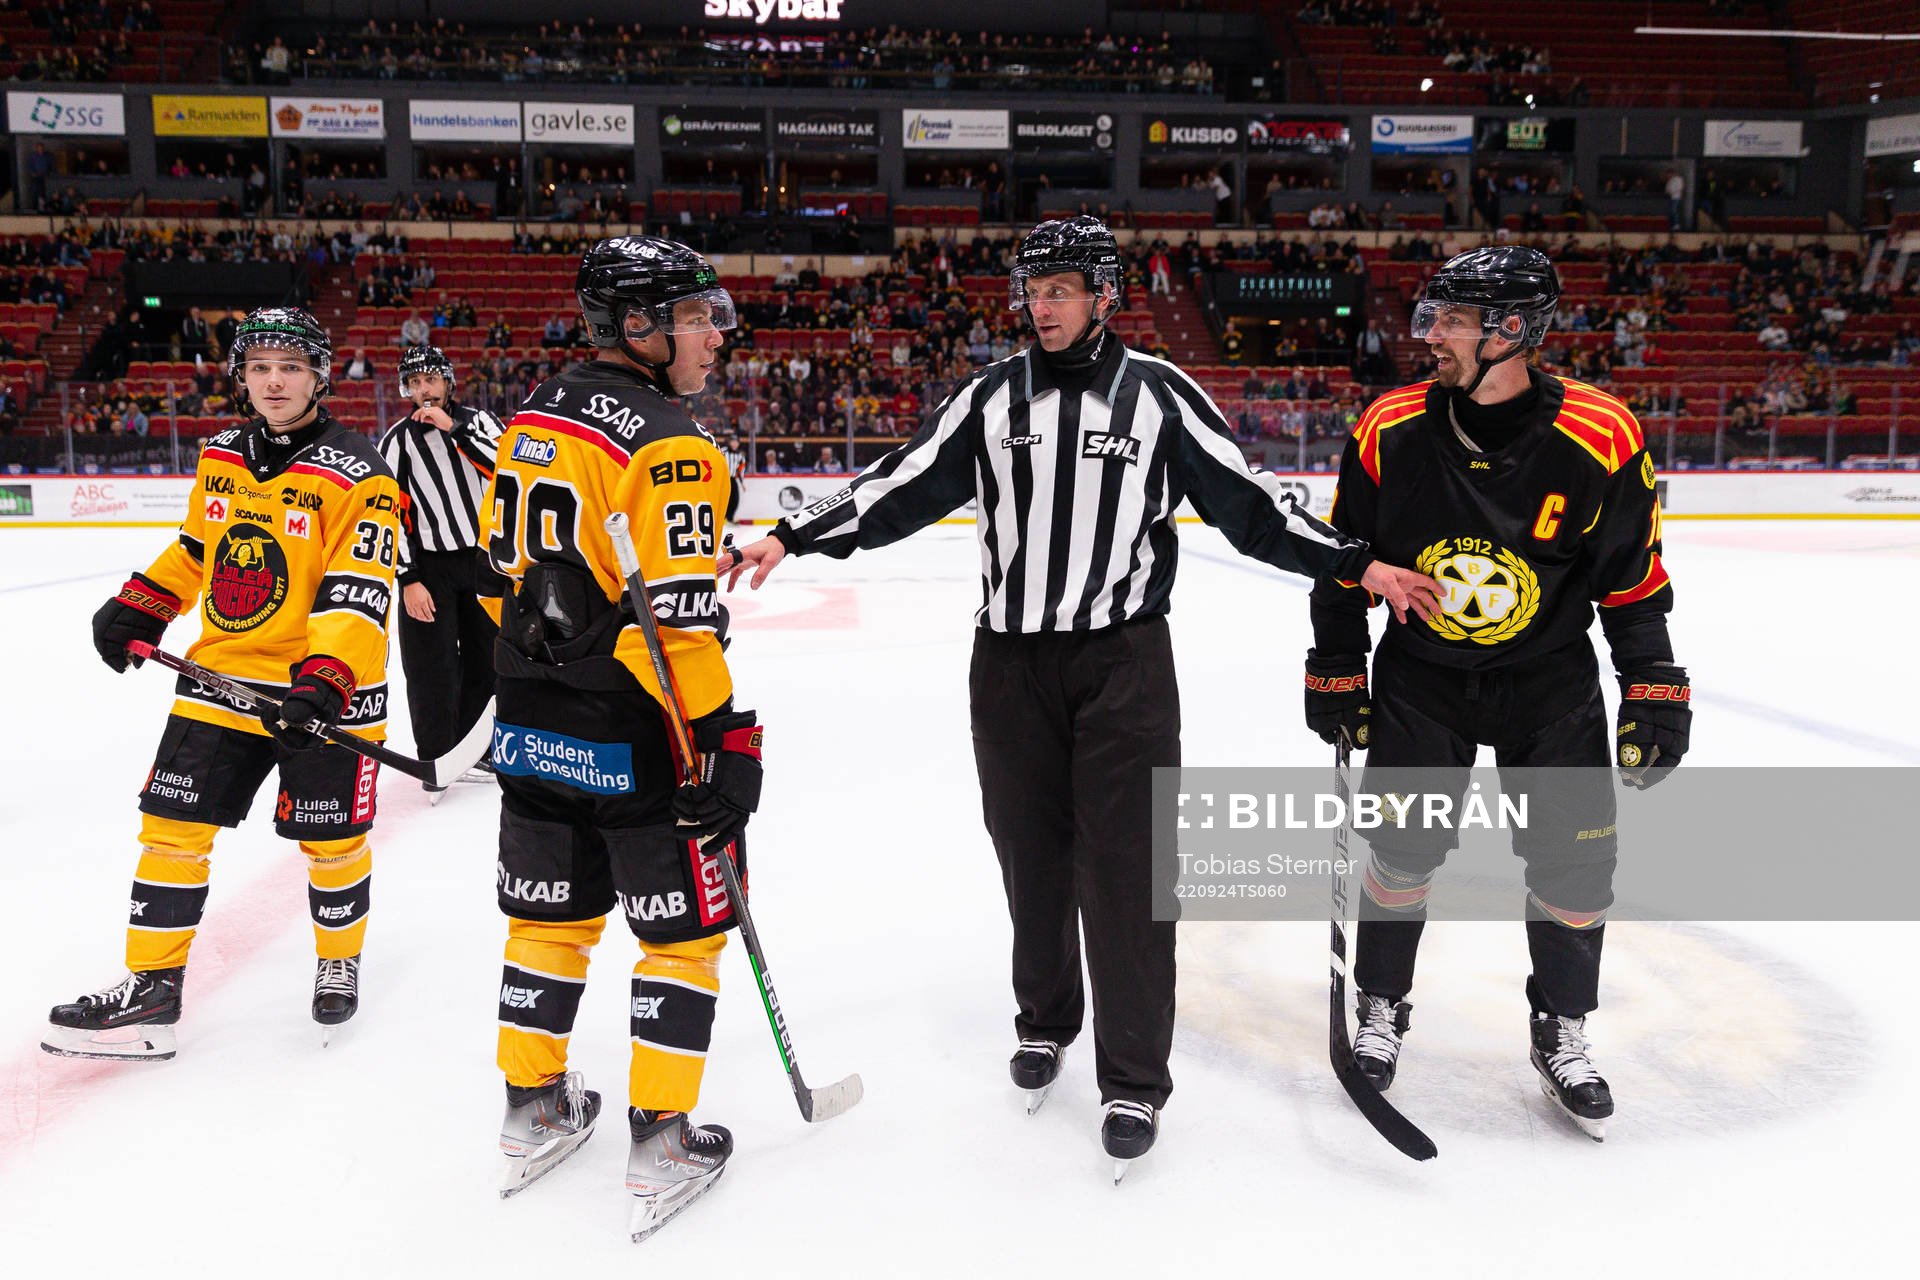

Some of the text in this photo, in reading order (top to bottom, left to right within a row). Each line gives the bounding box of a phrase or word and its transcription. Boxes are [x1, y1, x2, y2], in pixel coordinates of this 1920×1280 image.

[704, 0, 843, 24] Skybar
[64, 106, 103, 127] SSG
[188, 108, 261, 122] Ramudden
[412, 113, 519, 129] Handelsbanken
[531, 109, 627, 137] gavle.se
[683, 120, 761, 132] GRÄVTEKNIK
[778, 122, 874, 136] HAGMANS TAK
[1017, 124, 1094, 137] BILBOLAGET
[1171, 127, 1238, 144] KUSBO
[620, 240, 658, 258] LKAB
[1024, 247, 1051, 257] CCM
[581, 393, 645, 440] SSAB
[1002, 435, 1041, 447] CCM
[1083, 434, 1138, 460] SHL
[311, 445, 372, 477] SSAB
[1469, 461, 1491, 470] SHL
[73, 484, 116, 500] ABC
[812, 487, 853, 515] CCM
[234, 508, 274, 524] SCANIA
[1532, 491, 1567, 541] C
[663, 501, 715, 560] 29
[351, 518, 394, 569] 38
[1453, 536, 1493, 556] 1912
[213, 561, 273, 589] LULEÅ
[1467, 562, 1481, 575] B
[117, 586, 179, 620] BAUER
[206, 575, 286, 630] HOCKEYFÖRENING 1977
[212, 578, 271, 618] HOCKEY
[348, 585, 389, 615] LKAB
[677, 592, 719, 617] LKA
[340, 692, 385, 720] SAB
[524, 733, 596, 768] Student
[154, 768, 193, 788] Luleå
[527, 753, 630, 791] Consulting
[150, 782, 199, 803] Energi
[296, 797, 340, 811] Luleå
[295, 811, 348, 825] Energi
[1576, 823, 1617, 841] BAUER
[503, 871, 571, 903] LKAB
[318, 901, 356, 919] NEX
[625, 891, 688, 921] LKAB
[500, 984, 545, 1009] NEX
[631, 996, 666, 1020] NEX
[761, 968, 798, 1069] BAUER
[655, 1154, 706, 1177] VAPOR
[688, 1153, 716, 1166] BAUER
